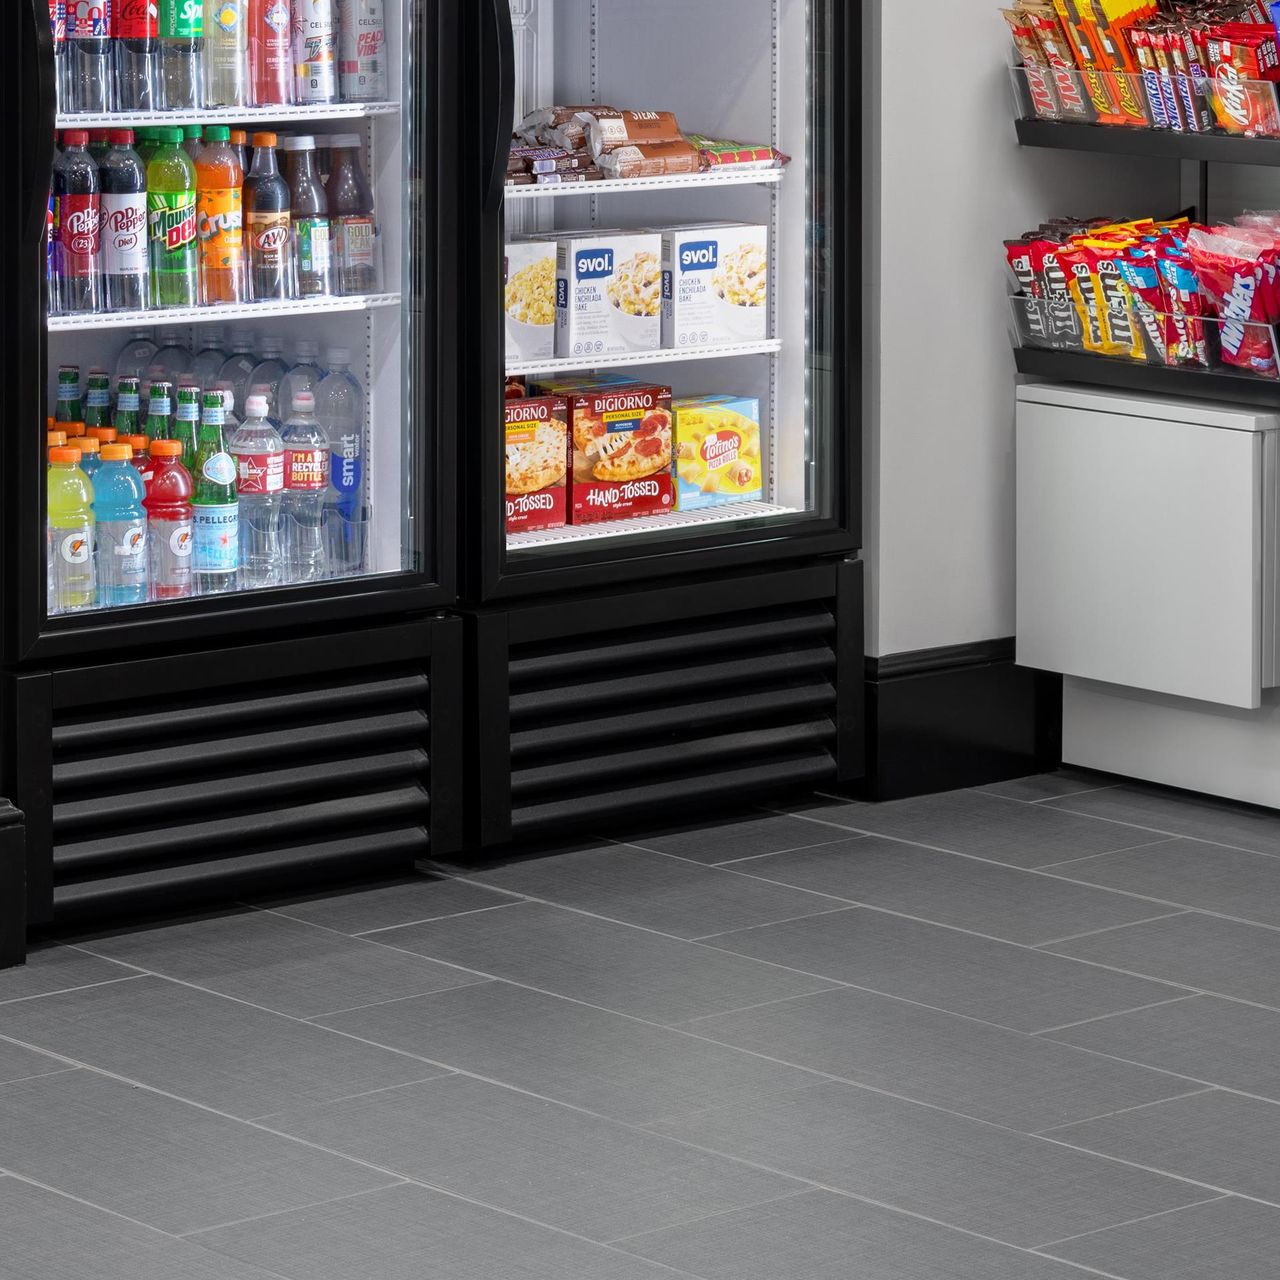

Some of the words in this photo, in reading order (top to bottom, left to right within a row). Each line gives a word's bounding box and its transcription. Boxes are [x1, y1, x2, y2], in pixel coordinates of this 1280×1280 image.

[357, 43, 378, 58] VIBE
[124, 206, 140, 221] Dr
[111, 212, 146, 235] Pepper
[118, 236, 134, 248] Diet
[678, 278, 701, 287] CHICKEN
[574, 286, 597, 295] CHICKEN
[678, 286, 707, 295] ENCHILADA
[574, 294, 602, 303] ENCHILADA
[678, 294, 693, 303] BAKE
[574, 303, 588, 312] BAKE
[605, 412, 628, 421] PERSONAL
[630, 410, 642, 419] SIZE
[704, 434, 739, 460] Totino's
[342, 433, 354, 487] smart
[291, 470, 322, 482] BOTTLE
